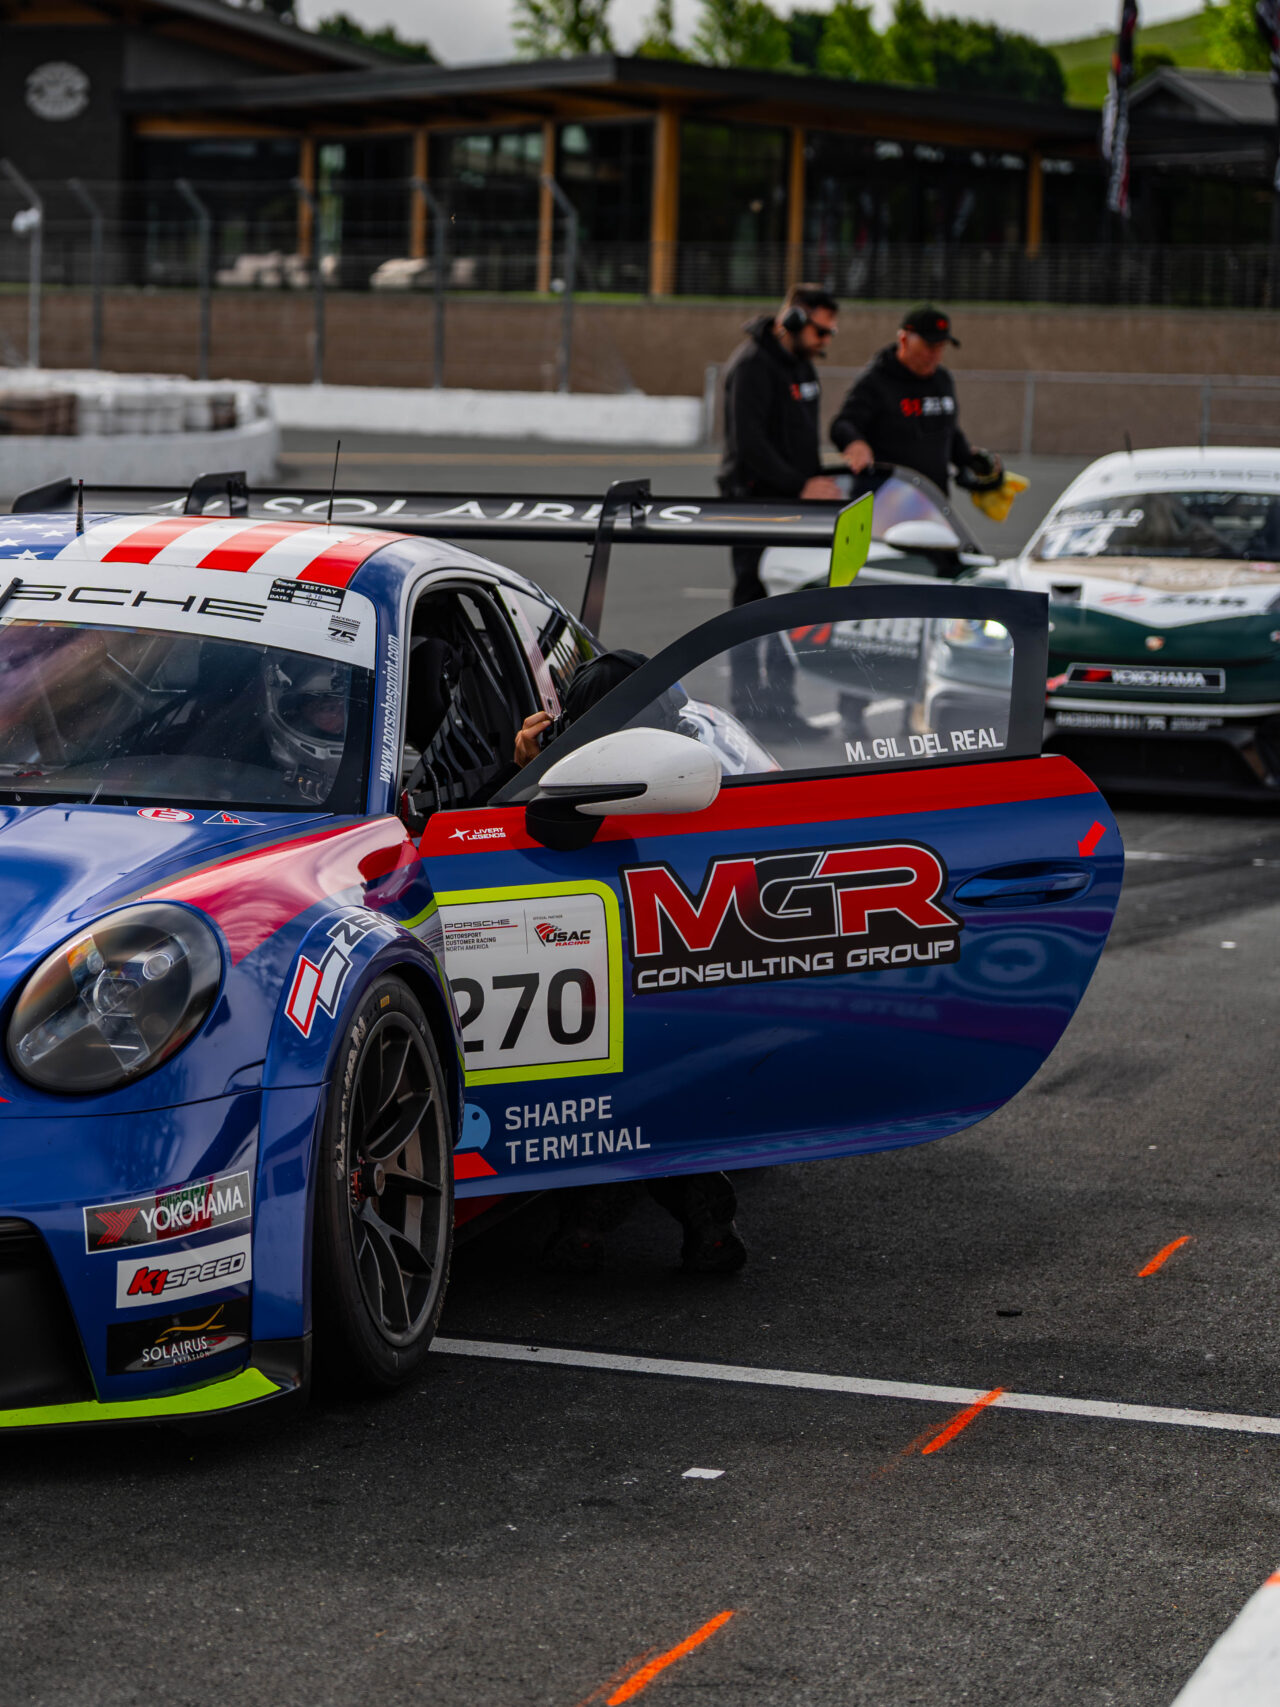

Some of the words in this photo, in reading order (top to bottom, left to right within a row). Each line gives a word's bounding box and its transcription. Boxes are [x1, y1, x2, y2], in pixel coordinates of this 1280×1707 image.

[301, 584, 319, 592] TEST
[320, 587, 338, 595] DAY
[327, 627, 357, 642] 75
[379, 633, 400, 784] www.porschesprint.com
[845, 741, 871, 763] M.
[872, 737, 906, 759] GIL
[909, 733, 948, 756] DEL
[951, 727, 1004, 752] REAL
[467, 832, 507, 840] LEGENDS
[473, 827, 505, 835] LIVERY
[623, 844, 959, 957] MGR
[444, 918, 511, 929] PORSCHE
[445, 931, 482, 940] MOTORSPORT
[445, 938, 476, 946] CUSTOMER
[545, 929, 592, 943] USAC
[637, 952, 834, 989] CONSULTING
[846, 940, 955, 968] GROUP
[450, 968, 596, 1053] 270
[504, 1095, 613, 1131] SHARPE
[505, 1126, 651, 1165] TERMINAL
[139, 1185, 245, 1234] YOKOHAMA
[141, 1335, 208, 1363] SOLAIRUS
[172, 1350, 210, 1365] AVIATION
